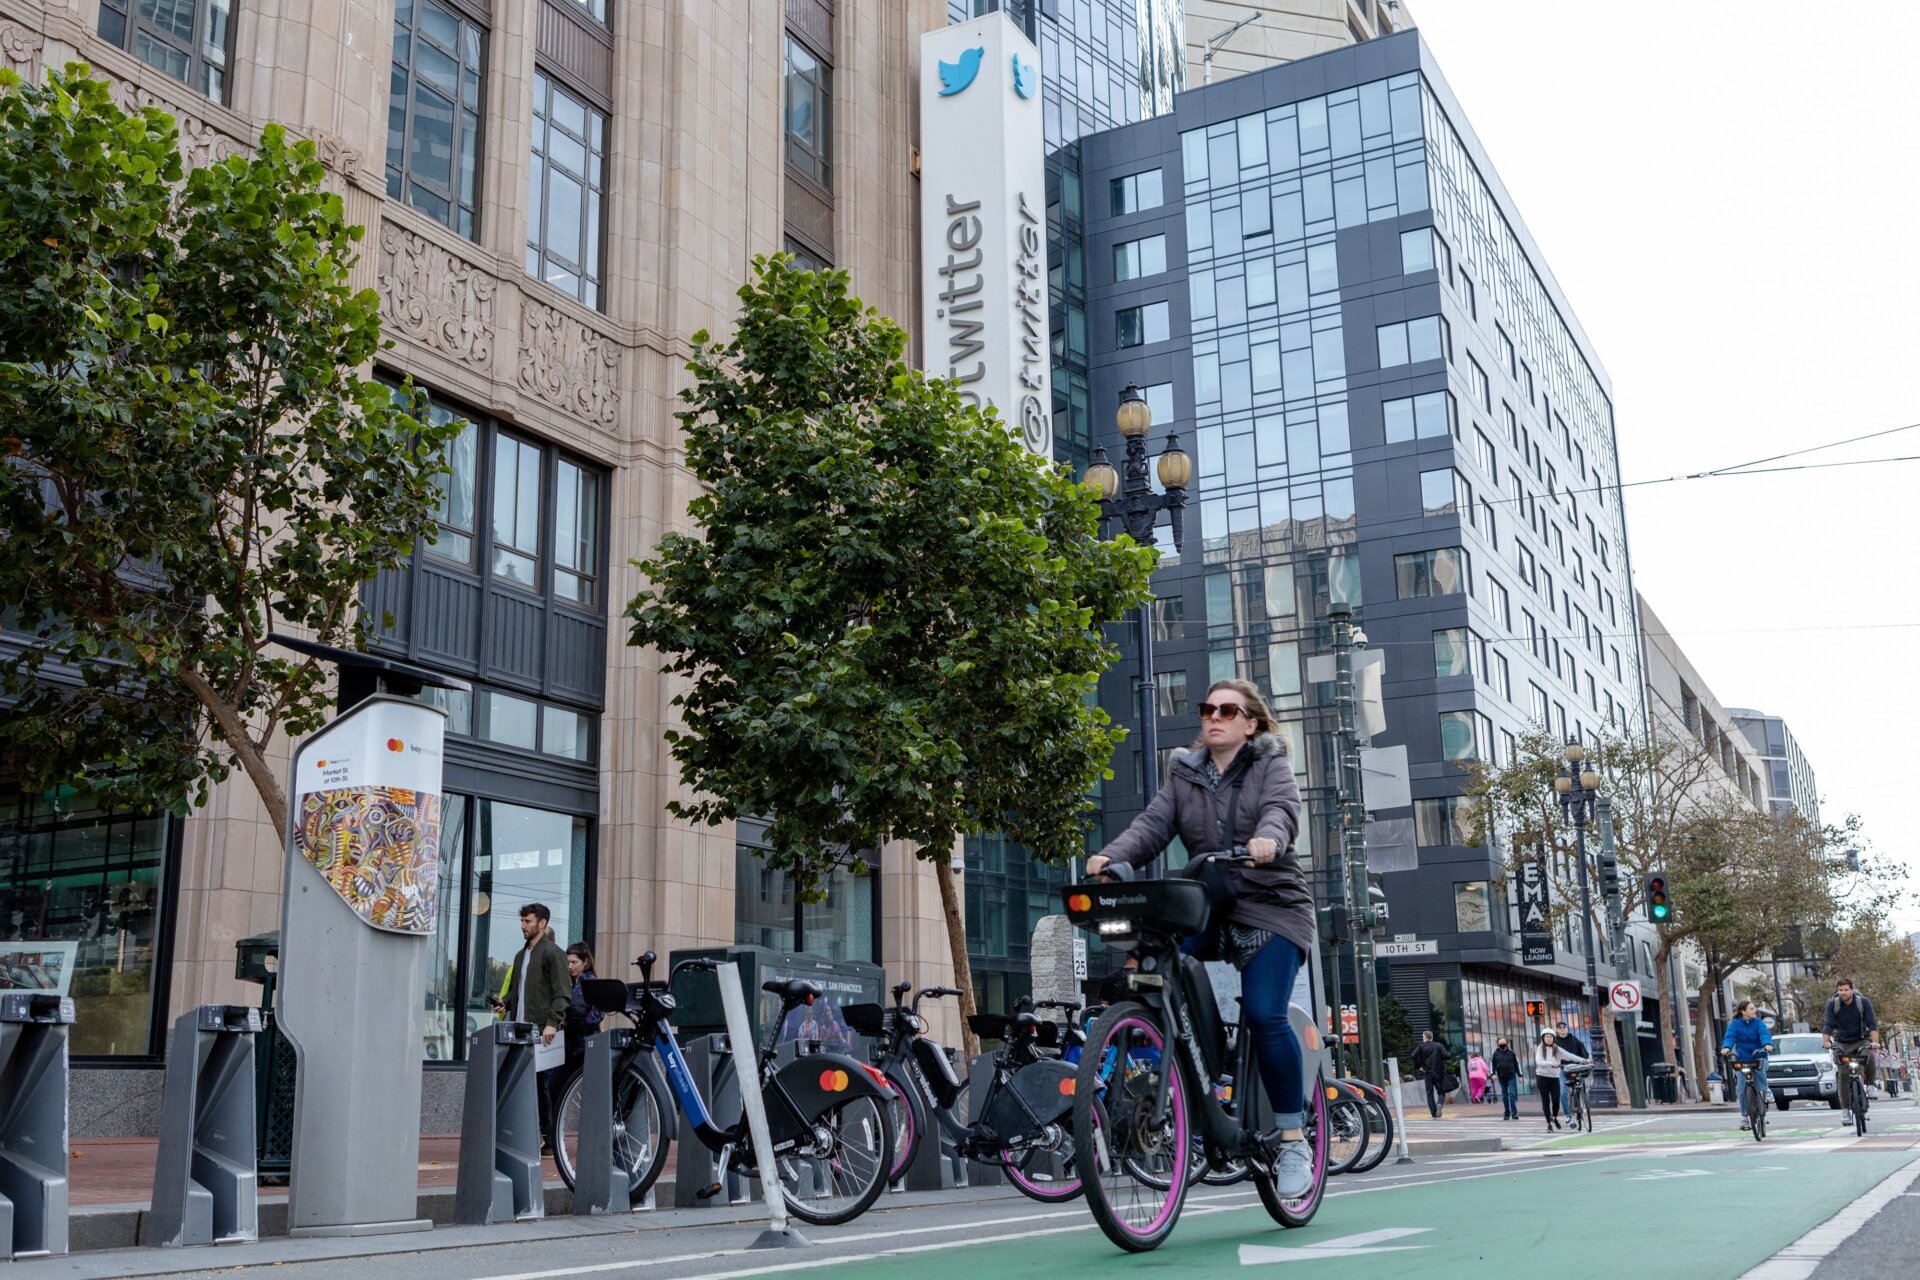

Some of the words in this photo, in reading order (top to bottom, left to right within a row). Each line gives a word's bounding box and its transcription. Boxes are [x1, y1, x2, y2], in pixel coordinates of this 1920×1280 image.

[1015, 191, 1050, 454] @twitter
[1385, 944, 1408, 954] 10TH
[1415, 943, 1426, 952] ST
[1529, 947, 1546, 955] NOW
[1524, 953, 1553, 962] LEASING
[1075, 960, 1086, 976] 25
